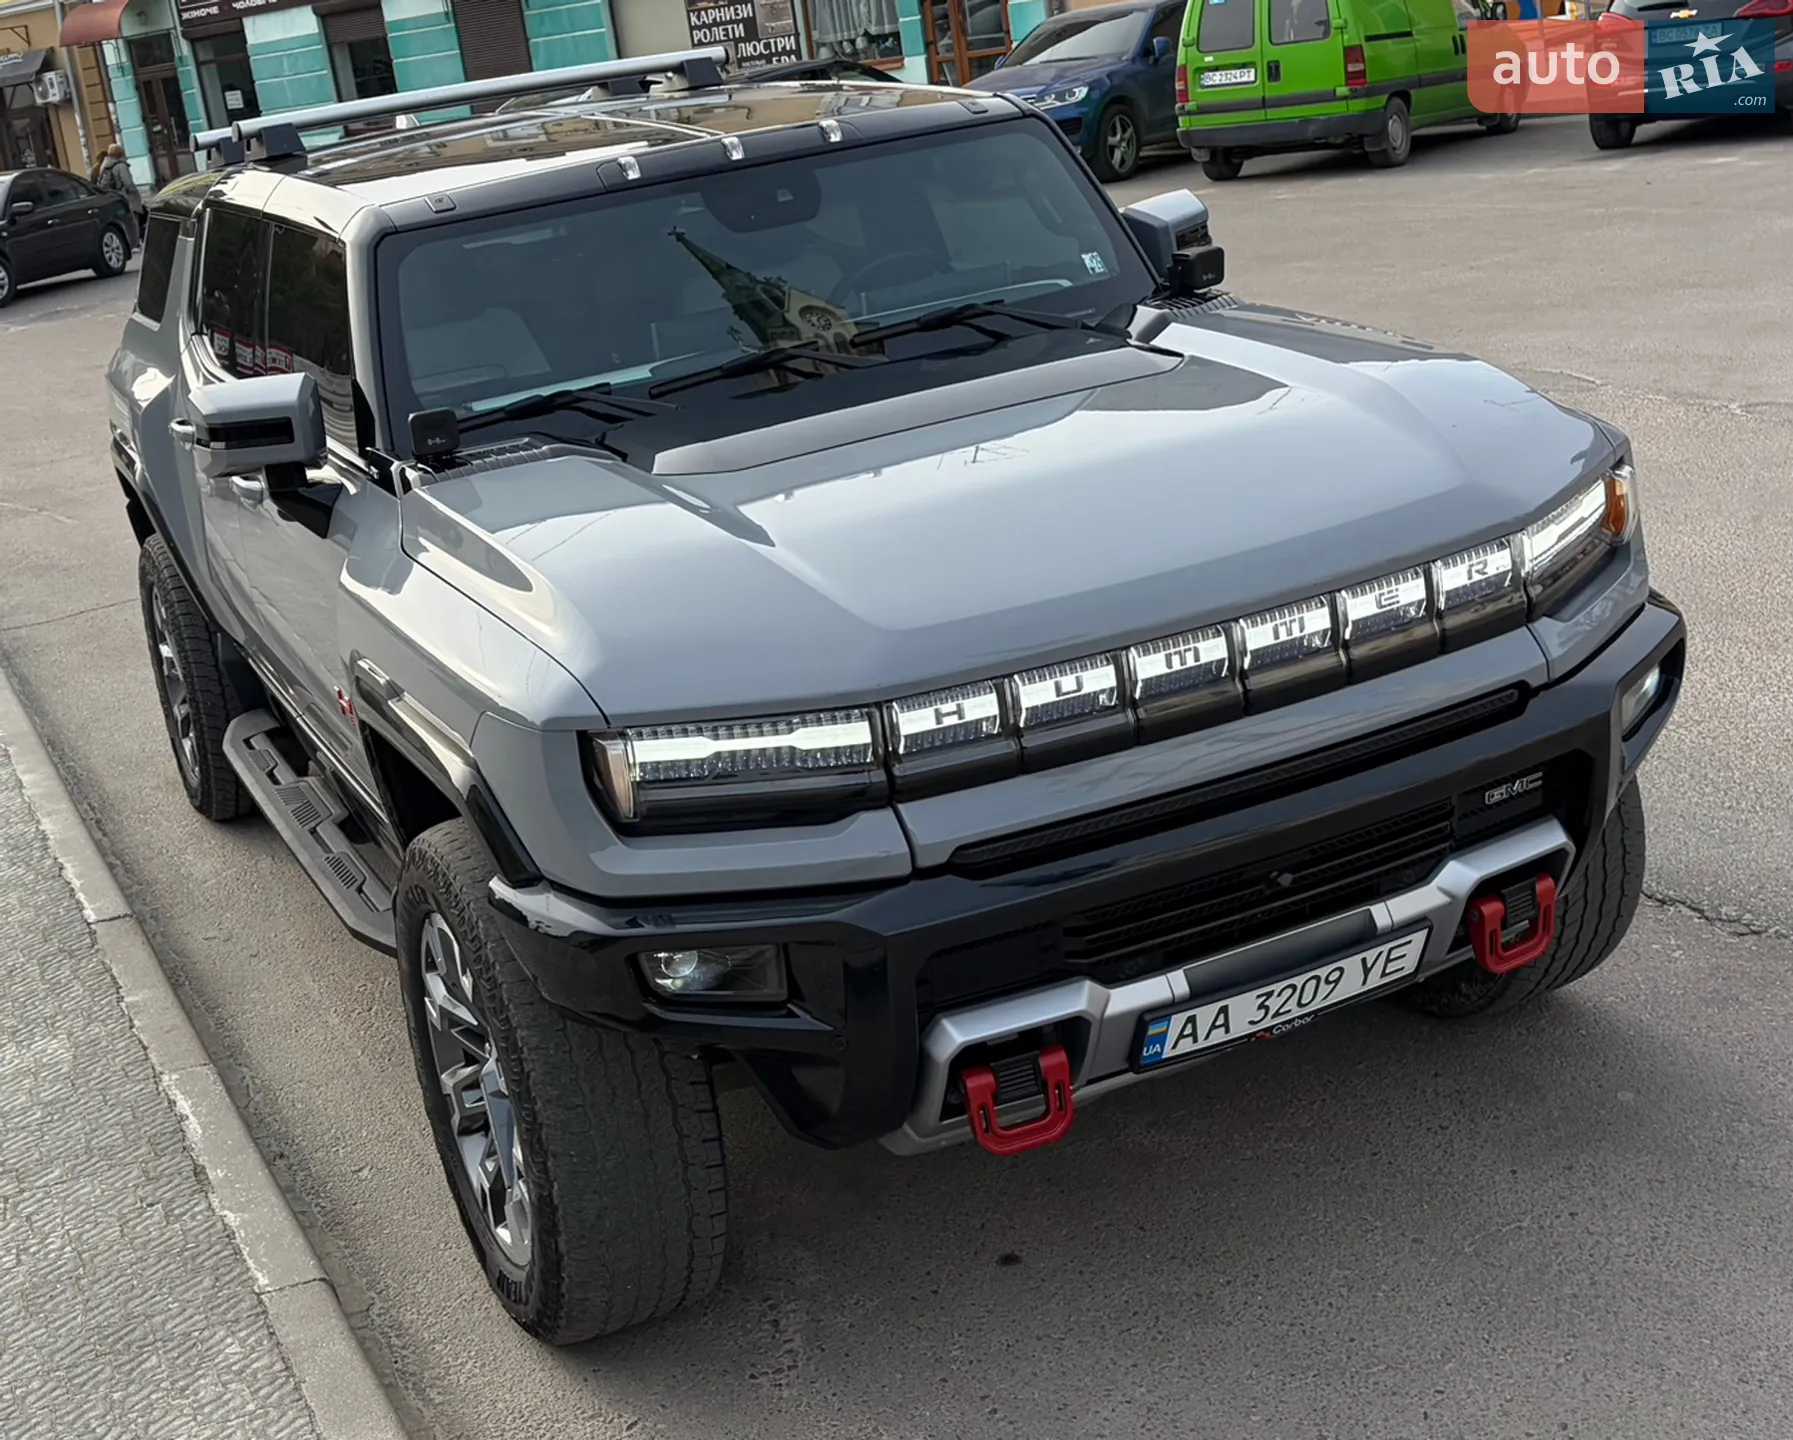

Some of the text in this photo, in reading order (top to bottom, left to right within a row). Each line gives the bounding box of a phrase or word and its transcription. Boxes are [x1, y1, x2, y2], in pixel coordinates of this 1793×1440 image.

[181, 6, 220, 20] ЖІНОЧЕ
[689, 3, 753, 26] КАРНИЗИ
[692, 23, 745, 44] РОЛЕТИ
[737, 35, 796, 58] ЛЮСТРИ
[1485, 771, 1543, 805] GMC
[1171, 939, 1414, 1050] AA 3209 YE
[1142, 1044, 1162, 1057] UA
